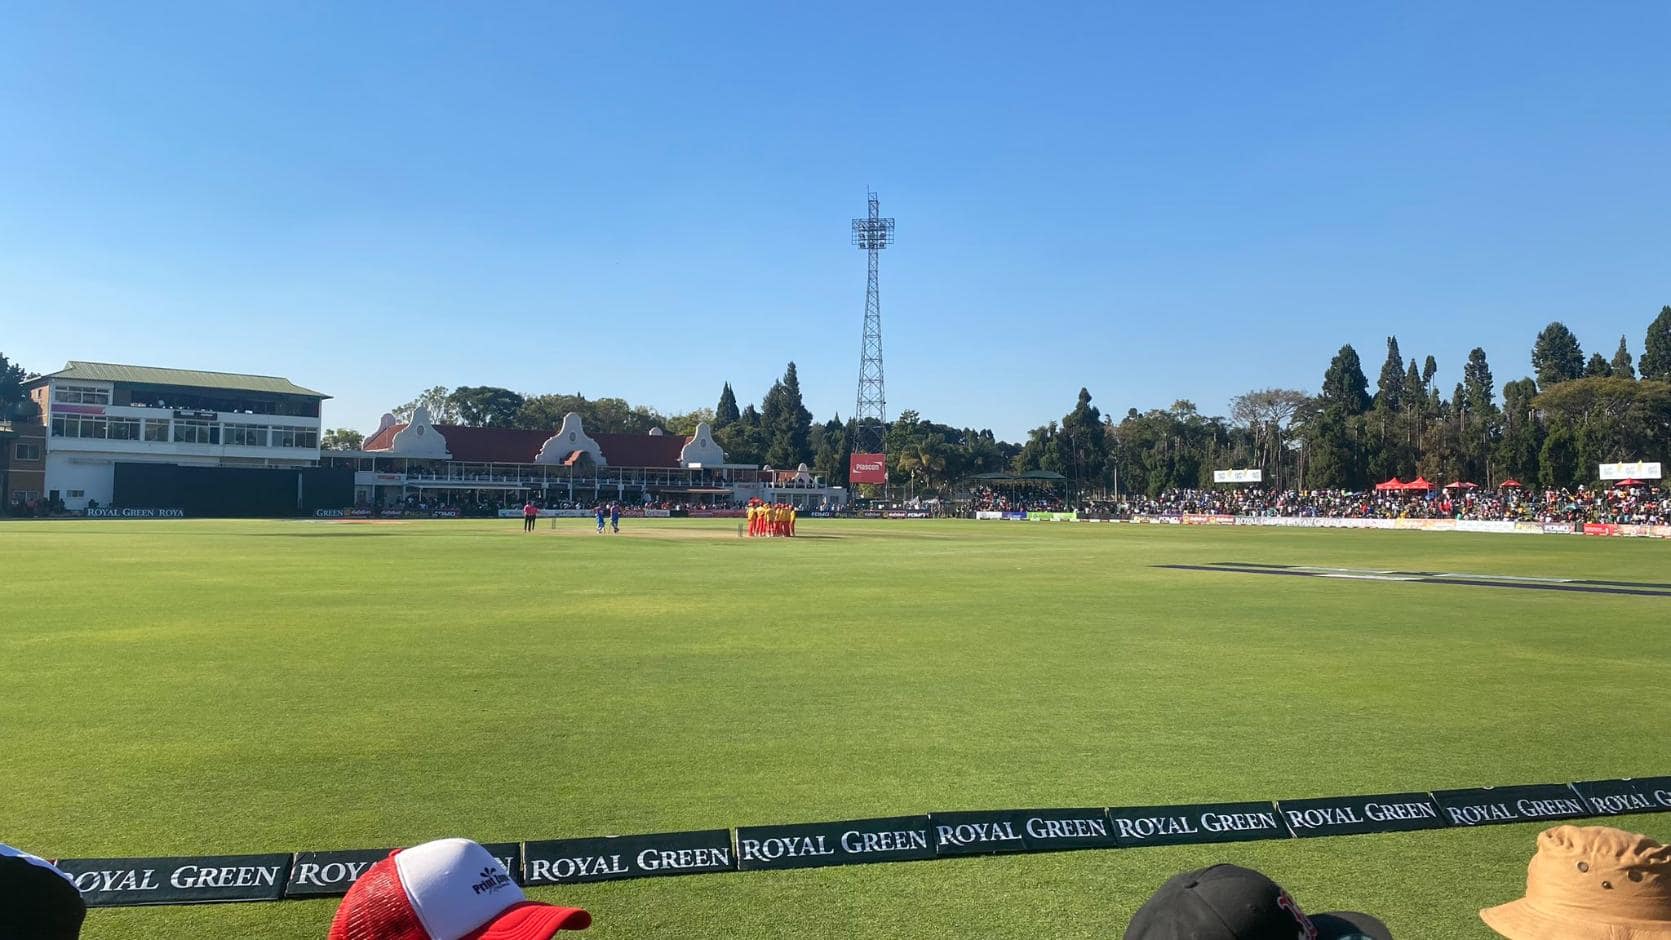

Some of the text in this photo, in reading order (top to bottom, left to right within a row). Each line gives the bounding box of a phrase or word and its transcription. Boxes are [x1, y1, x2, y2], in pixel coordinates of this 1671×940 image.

[87, 508, 121, 517] ROYAL
[122, 508, 154, 517] GREEN
[316, 508, 344, 517] GREEN
[1286, 802, 1438, 829] ROYAL GREEN
[1446, 798, 1583, 825] ROYAL GREEN
[1590, 793, 1656, 814] ROYAL
[935, 817, 1107, 847] ROYAL GREEN
[1114, 812, 1278, 839] ROYAL GREEN
[741, 830, 928, 862] ROYAL GREEN
[170, 865, 280, 889] GREEN
[296, 861, 378, 887] ROY
[529, 854, 629, 882] ROYAL
[636, 847, 730, 871] GREEN
